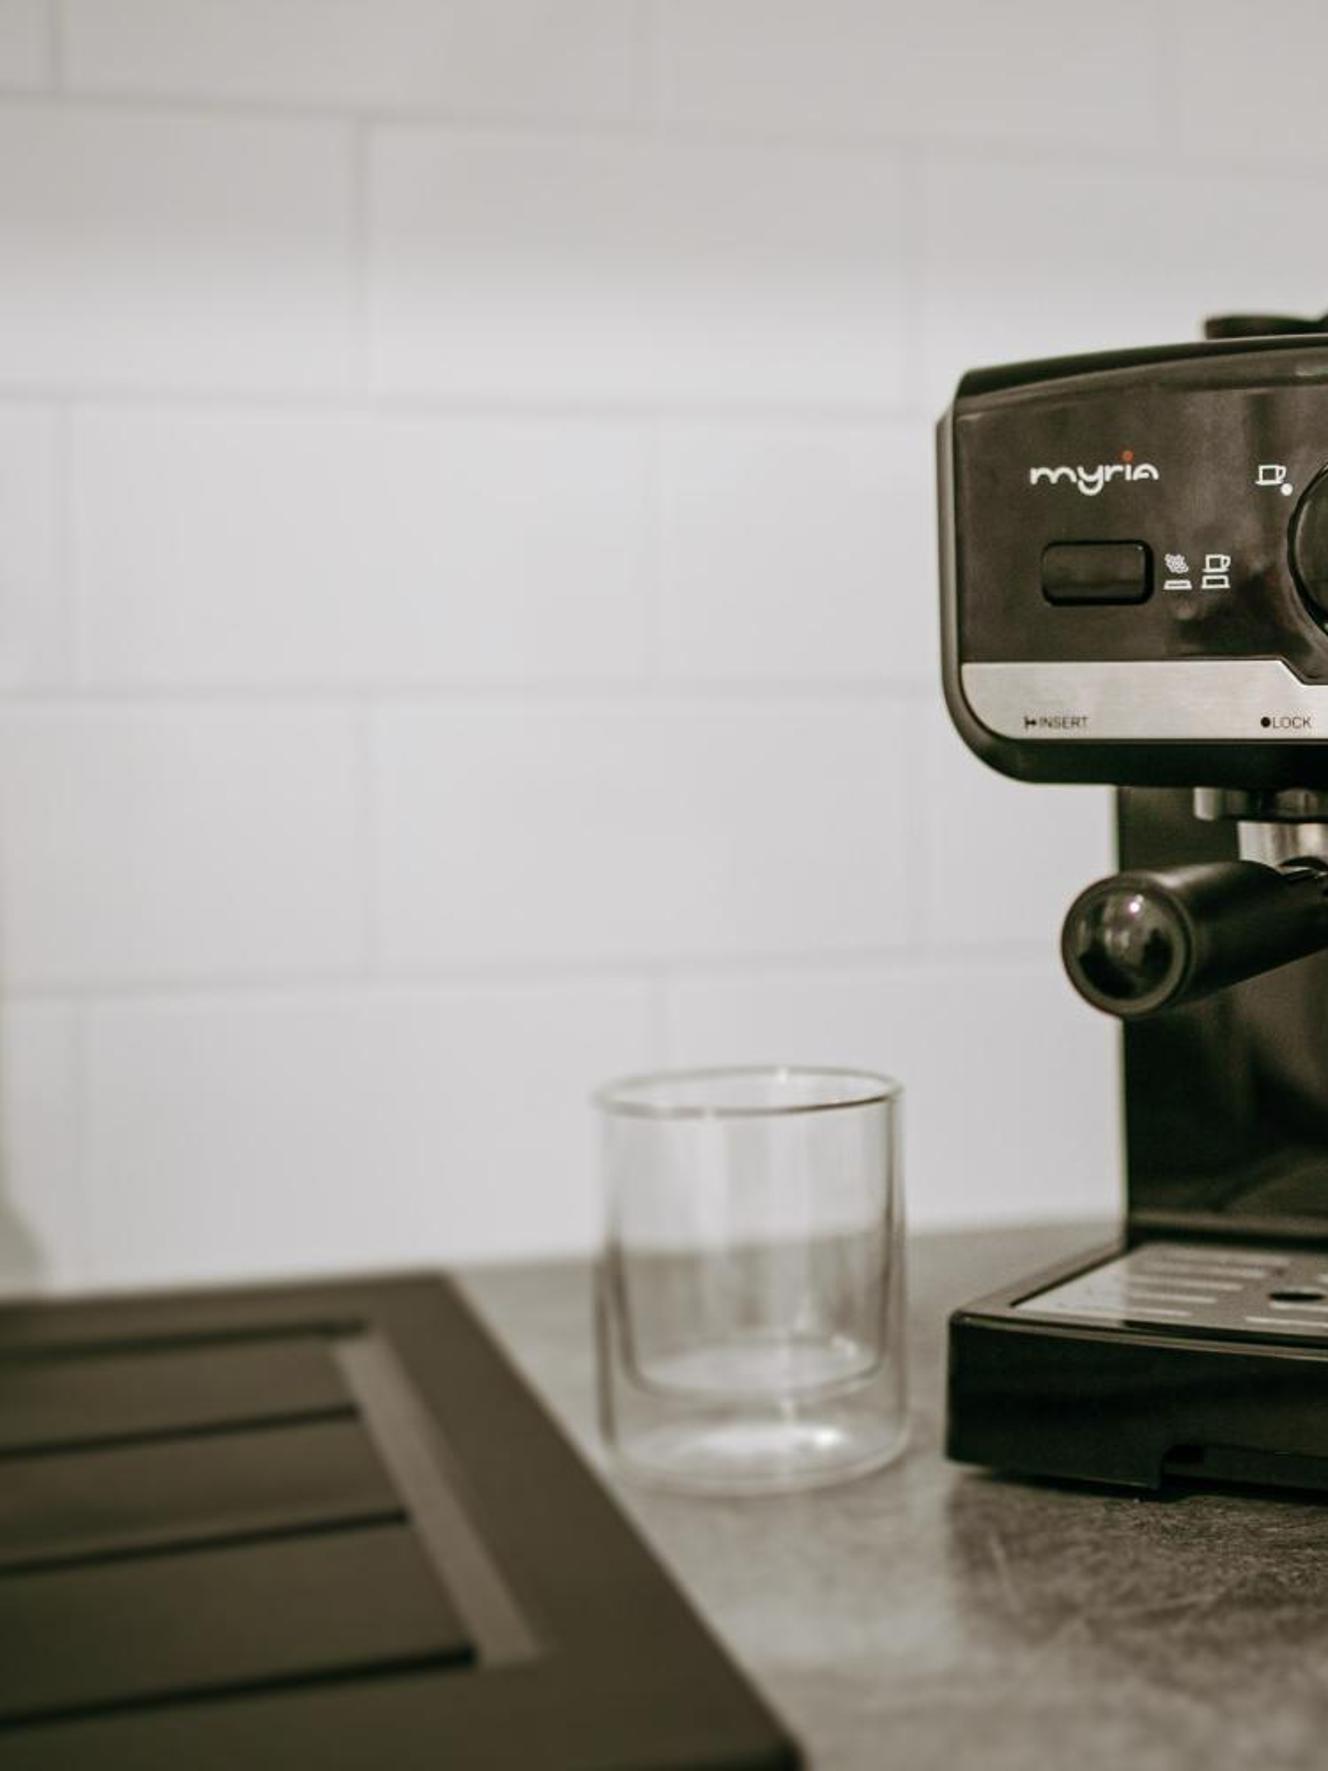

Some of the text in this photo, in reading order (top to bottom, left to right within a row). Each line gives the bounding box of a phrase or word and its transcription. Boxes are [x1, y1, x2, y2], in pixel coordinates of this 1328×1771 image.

[1030, 450, 1159, 495] myria
[1038, 716, 1088, 728] INSERT
[1272, 716, 1312, 728] LOCK
